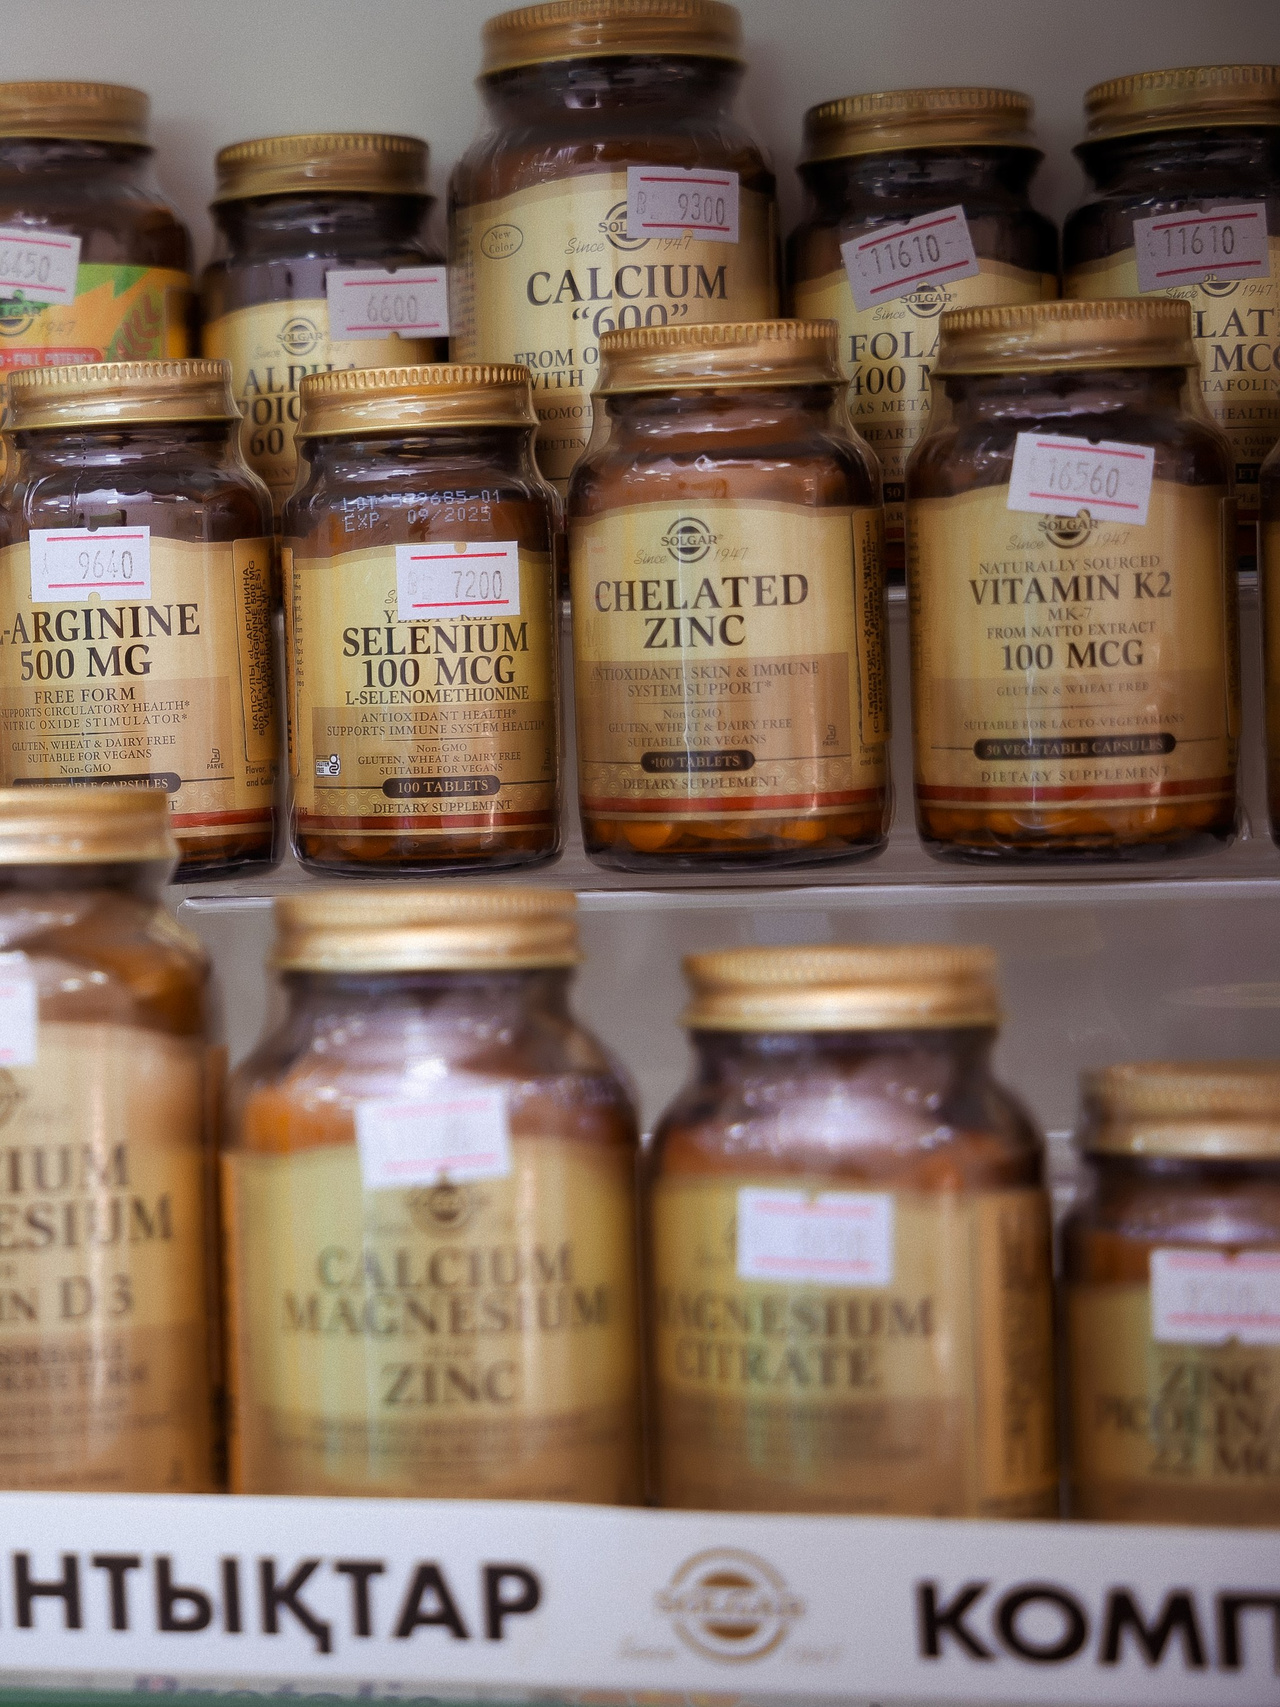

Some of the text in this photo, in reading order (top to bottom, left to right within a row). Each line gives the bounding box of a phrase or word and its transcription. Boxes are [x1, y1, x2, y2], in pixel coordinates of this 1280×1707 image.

[678, 193, 725, 226] 9300
[526, 265, 728, 306] CALCIUM
[901, 293, 952, 304] SOLGAR
[277, 332, 322, 341] SOLGAR
[848, 332, 940, 362] FOLA
[250, 428, 283, 455] 60
[661, 536, 718, 546] SOLGAR
[79, 550, 133, 580] 9640
[979, 555, 1160, 575] NATURALLY SOURCED
[452, 570, 502, 599] 7200
[595, 573, 808, 613] CHELATED
[969, 572, 1172, 605] VITAMIN K2
[1048, 607, 1091, 622] MK-7
[644, 615, 746, 649] ZINC
[987, 621, 1156, 640] FROM NATTO EXTRACT
[342, 622, 529, 657] SELENIUM
[20, 644, 152, 681] 500 MG
[1001, 640, 1143, 671] 100 MCG
[363, 655, 516, 689] 100 MCG
[35, 687, 135, 704] FREE FORM
[345, 686, 529, 705] L-SELENOMETHIONINE
[628, 684, 682, 697] SYSTEM
[1, 707, 41, 719] SUPPORTS
[44, 704, 129, 717] CIRCULATORY
[361, 711, 458, 723] ANTIOXIDANT
[4, 721, 35, 731] NITRIC
[40, 719, 80, 729] OXIDE
[327, 725, 385, 737] SUPPORTS
[389, 724, 447, 735] IMMUNE
[451, 722, 498, 734] SYSTEM
[12, 735, 176, 751] GLUTEN, WHEAT & DAIRY FREE
[416, 743, 467, 753] Non-GMO
[28, 749, 152, 763] SUITABLE FOR VEGANS
[358, 751, 521, 766] GLUTEN, WHEAT & DAIRY FREE
[60, 764, 111, 774] Non-GMO
[981, 766, 1171, 783] DIETARY SUPPLEMENT
[397, 780, 489, 794] 100 TABLETS
[623, 776, 779, 790] DIETARY SUPPLEMENT
[373, 800, 512, 814] DIETARY SUPPLEMENT
[317, 1242, 573, 1289] CALCIUM
[382, 1360, 518, 1407] ZINC
